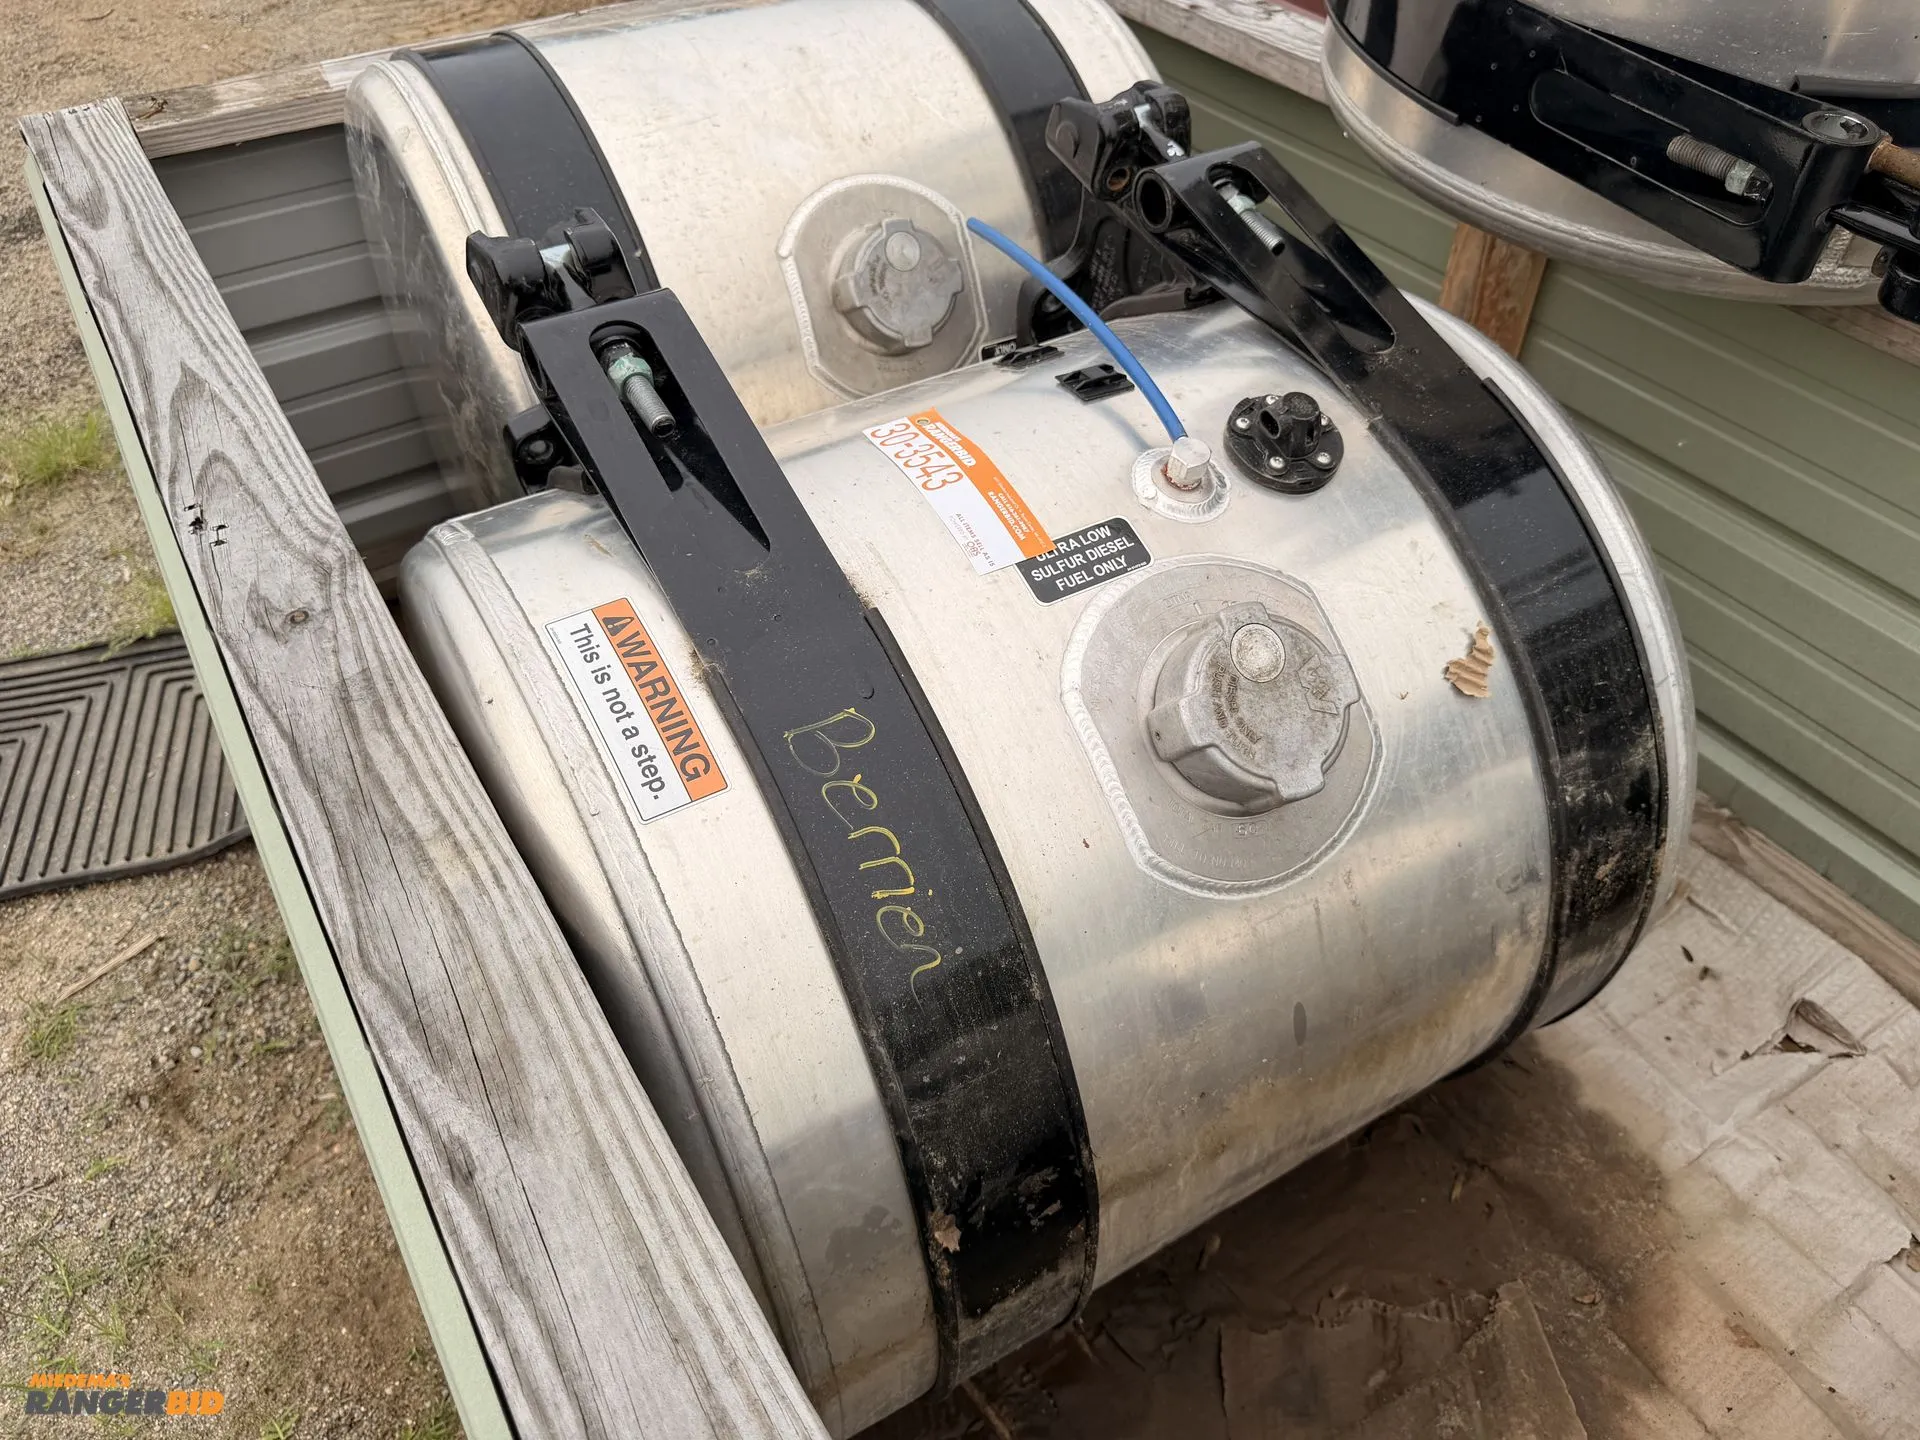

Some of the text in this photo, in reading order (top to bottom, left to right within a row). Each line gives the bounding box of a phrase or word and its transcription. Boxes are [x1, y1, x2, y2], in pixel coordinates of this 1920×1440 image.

[870, 423, 964, 490] 30-3543
[922, 423, 976, 468] RANGERBID
[956, 514, 965, 522] ALL
[962, 522, 976, 538] ITEMS
[974, 538, 984, 550] SELL
[982, 552, 990, 560] AS
[988, 491, 1026, 540] RANGERBID.COM
[1079, 525, 1112, 546] LOW
[1031, 536, 1134, 582] SULFUR DIESEL
[1056, 570, 1094, 592] FUEL
[1092, 555, 1128, 576] ONLY
[570, 623, 666, 800] This is not a step.
[616, 630, 710, 782] WARNING
